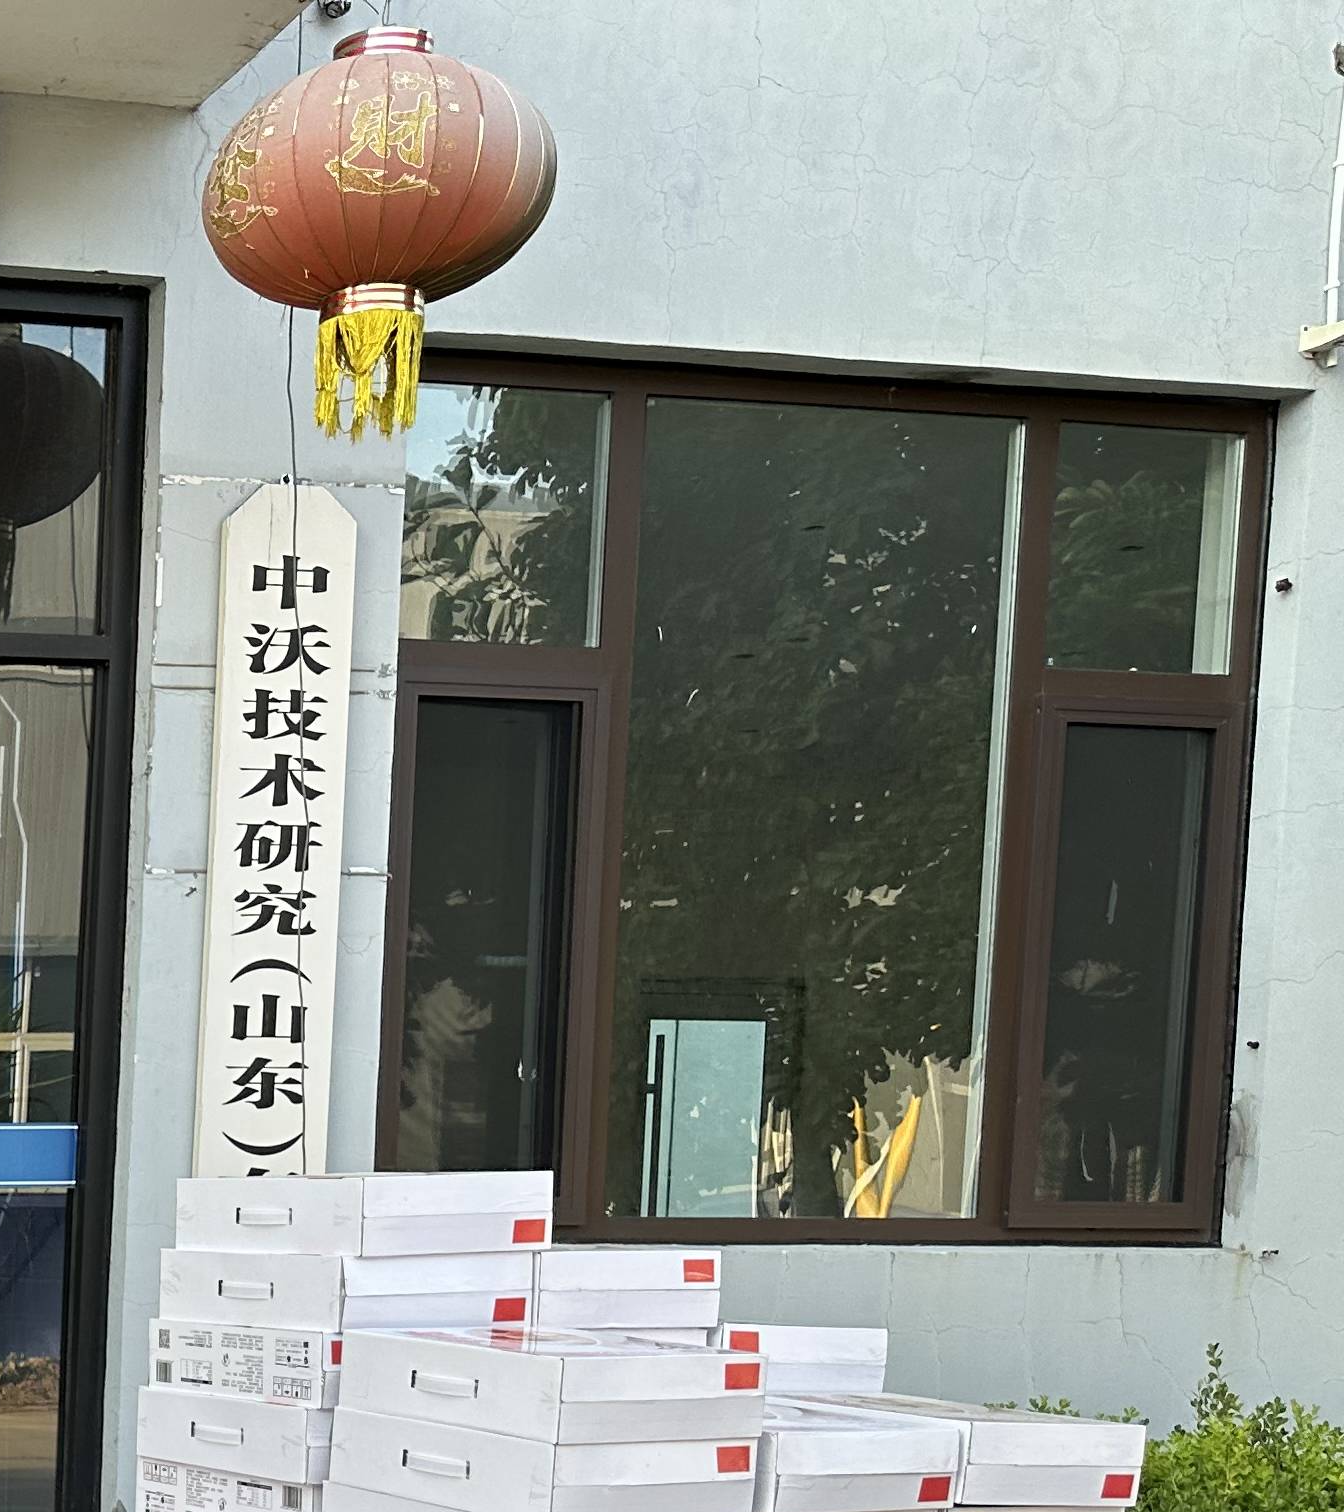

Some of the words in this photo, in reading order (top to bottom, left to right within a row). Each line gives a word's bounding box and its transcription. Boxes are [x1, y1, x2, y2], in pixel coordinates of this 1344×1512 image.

[222, 554, 331, 1176] 中沃技术研究（山东）
